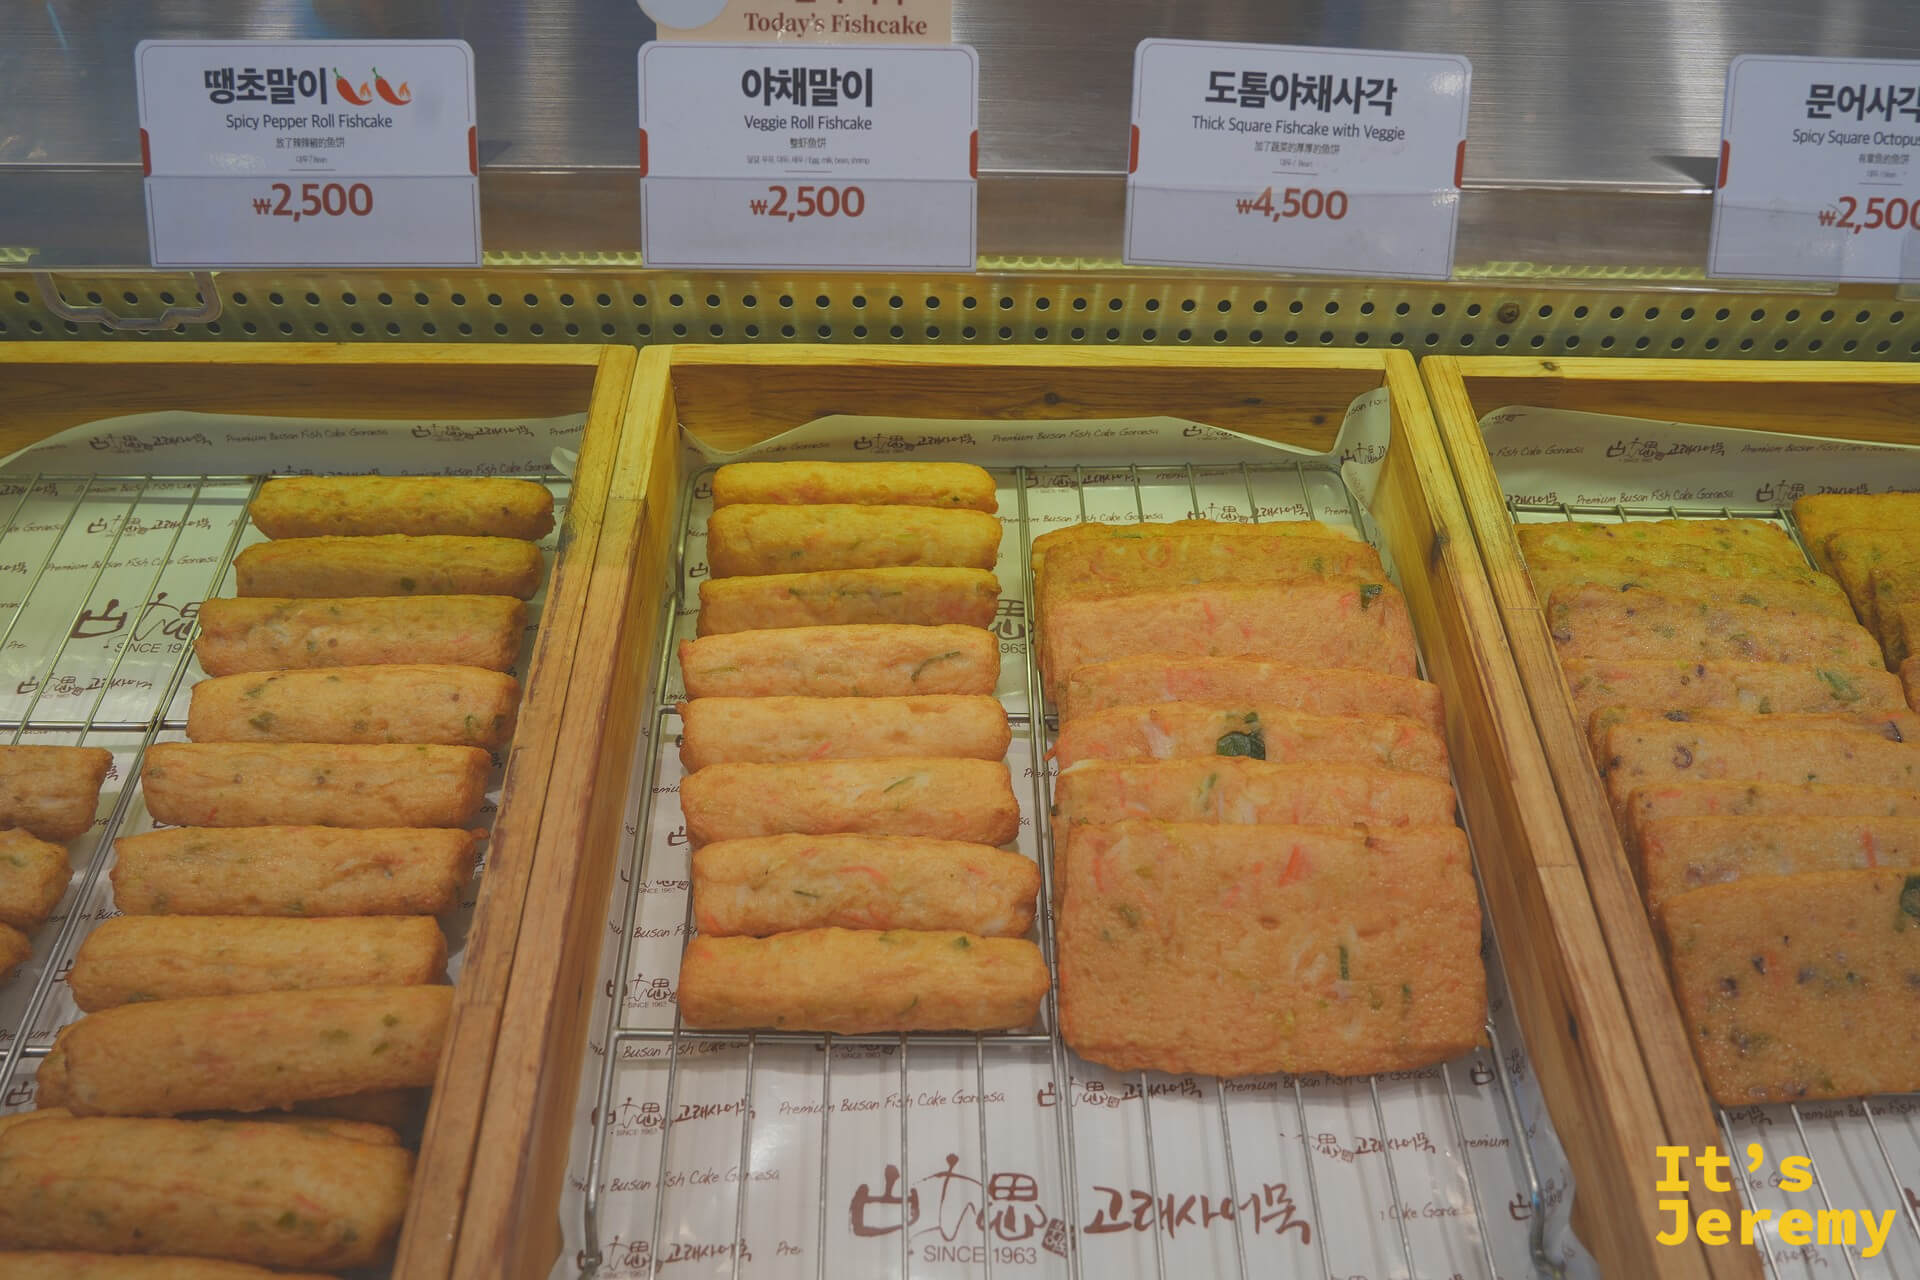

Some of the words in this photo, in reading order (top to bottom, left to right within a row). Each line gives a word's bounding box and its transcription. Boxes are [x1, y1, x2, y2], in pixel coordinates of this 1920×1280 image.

[744, 12, 824, 37] Today's
[831, 14, 927, 35] Fishcake
[204, 67, 328, 105] 땡초말이
[741, 67, 873, 107] 야채말이
[1205, 71, 1397, 117] 도톰야채사각
[226, 114, 259, 131] Spicy
[263, 114, 308, 131] Pepper
[312, 113, 335, 128] Roll
[339, 113, 393, 128] Fishcake
[744, 115, 787, 132] Veggie
[791, 115, 814, 129] Roll
[818, 115, 872, 131] Fishcake
[1192, 115, 1225, 131] Thick
[1229, 117, 1272, 135] Square
[1275, 120, 1329, 137] Fishcake
[1333, 123, 1360, 138] with
[1364, 125, 1405, 142] Veggie
[1792, 128, 1825, 146] Spicy
[1828, 130, 1870, 146] Square
[253, 183, 373, 222] ₩2,500
[749, 185, 865, 223] ₩2,500
[1236, 186, 1348, 223] ₩4,500
[634, 926, 670, 938] Busan
[622, 1044, 661, 1058] Busan
[1224, 1079, 1277, 1092] Premium
[840, 1098, 880, 1112] Busan
[917, 1090, 947, 1107] Cake
[610, 1178, 650, 1192] Busan
[689, 1167, 720, 1185] Cake
[923, 1245, 985, 1263] SINCE
[992, 1247, 1037, 1264] 1963
